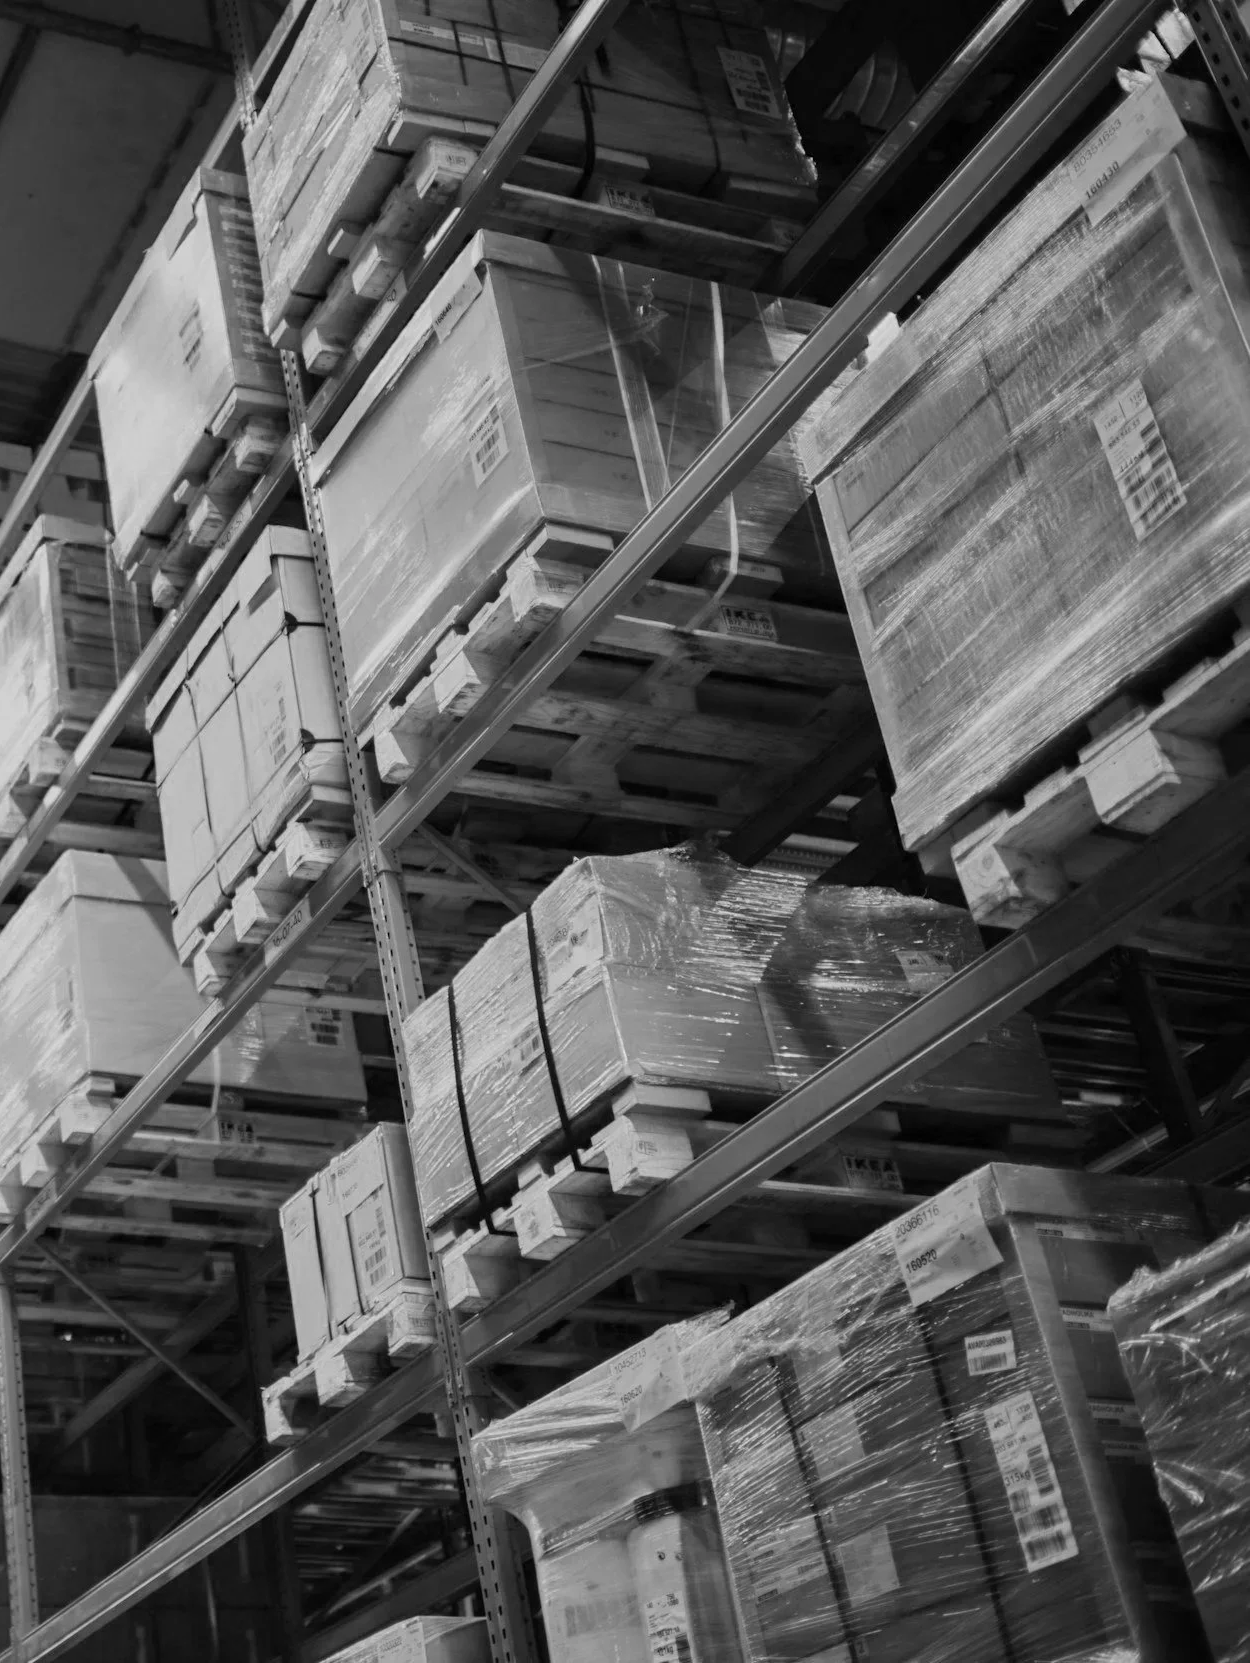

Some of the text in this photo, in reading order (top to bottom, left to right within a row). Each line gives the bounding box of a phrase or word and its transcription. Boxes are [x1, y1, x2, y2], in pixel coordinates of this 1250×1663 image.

[1073, 118, 1121, 172] 80354653
[1085, 160, 1119, 200] 160430
[725, 607, 770, 623] IKEA
[844, 1156, 895, 1173] IKEA
[894, 1203, 940, 1239] 20366116
[905, 1248, 938, 1274] 160520
[1004, 1470, 1031, 1488] 315kg
